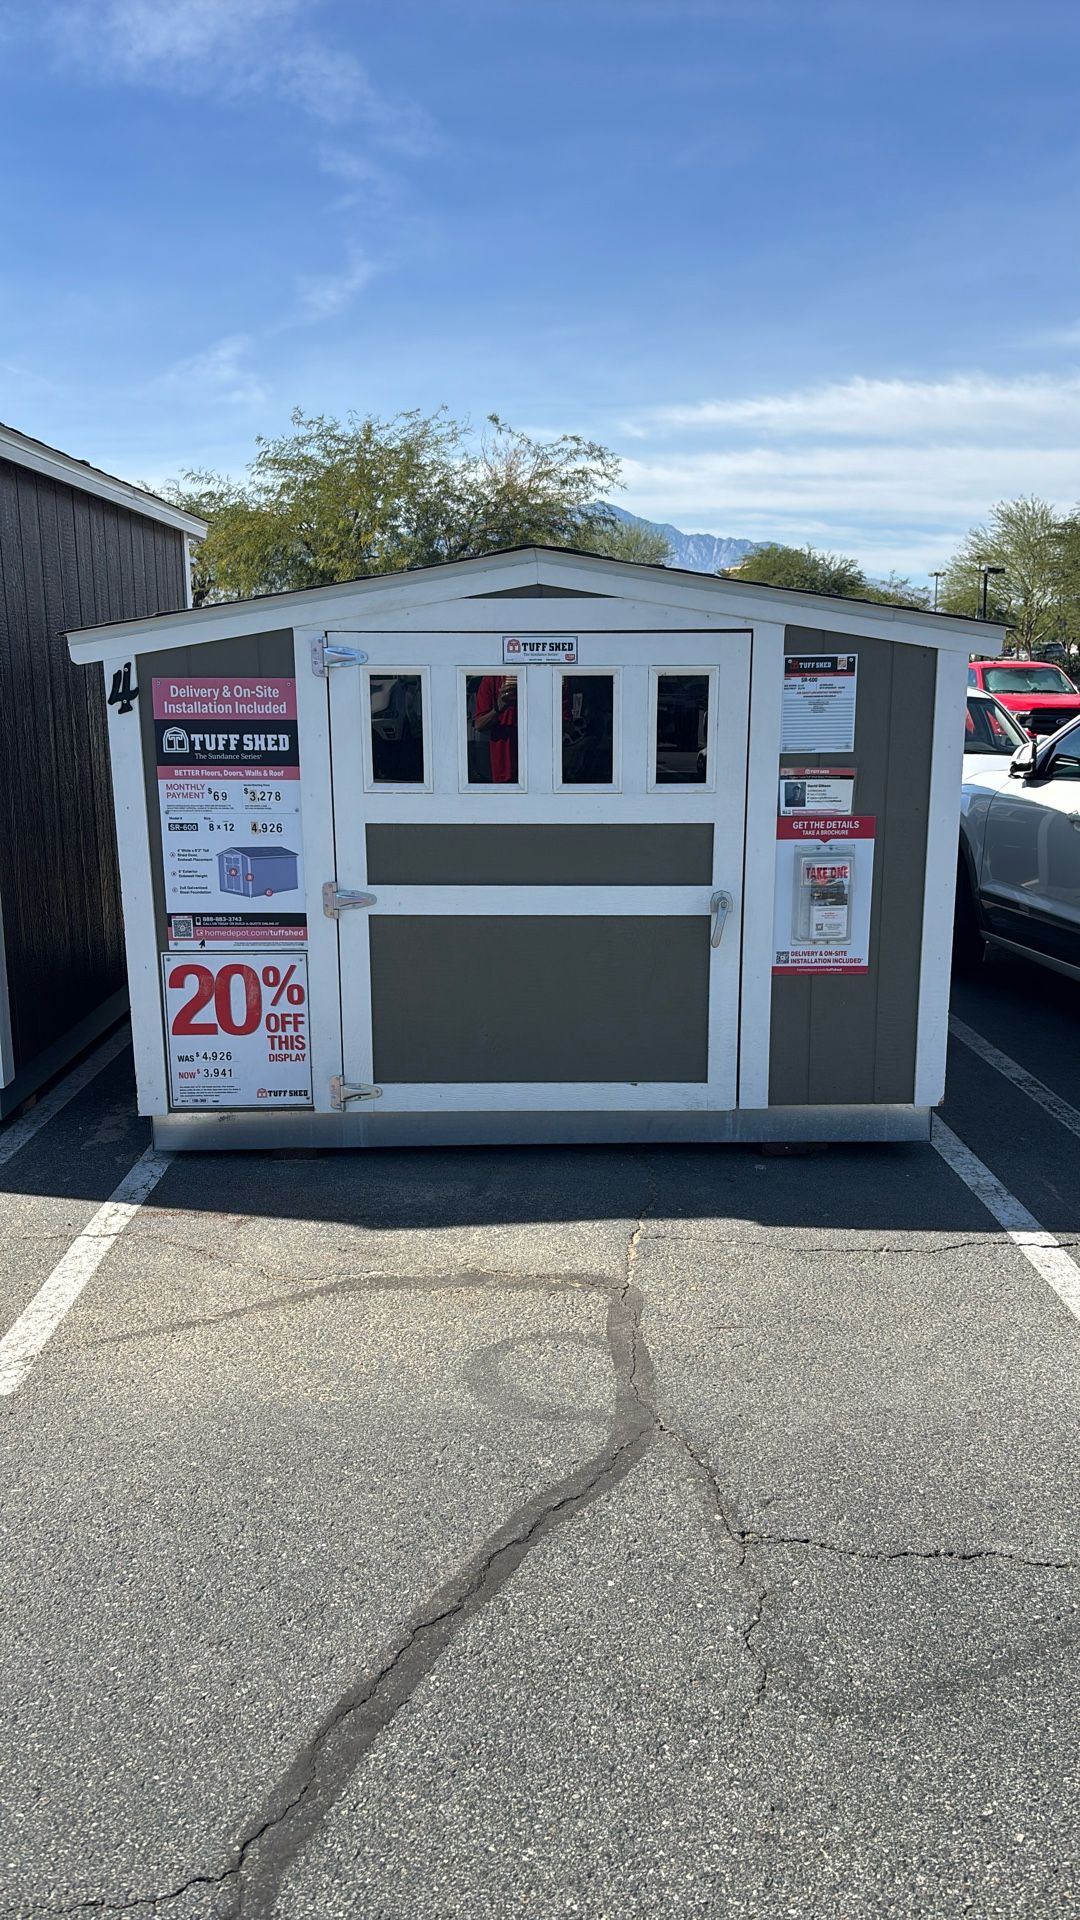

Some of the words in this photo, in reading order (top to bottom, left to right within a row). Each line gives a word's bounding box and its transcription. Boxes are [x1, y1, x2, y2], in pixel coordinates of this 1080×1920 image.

[522, 643, 548, 651] TUFF
[548, 643, 573, 651] SHED
[108, 662, 139, 714] 4
[170, 685, 220, 699] Delivery
[222, 686, 231, 698] &
[233, 685, 280, 698] On-Site
[164, 701, 232, 714] Installation
[235, 701, 287, 714] Included
[191, 734, 240, 750] TUFF
[243, 734, 290, 751] SHED
[209, 823, 214, 832] 8
[224, 823, 234, 832] 12
[252, 823, 282, 832] 4,926
[806, 867, 828, 879] TAKE
[831, 866, 848, 879] ONE
[204, 929, 304, 937] homedepot.com/tuffshed
[169, 964, 306, 1035] 20%
[266, 1013, 305, 1033] OFF
[267, 1035, 306, 1050] THIS
[269, 1054, 306, 1062] DISPLAY
